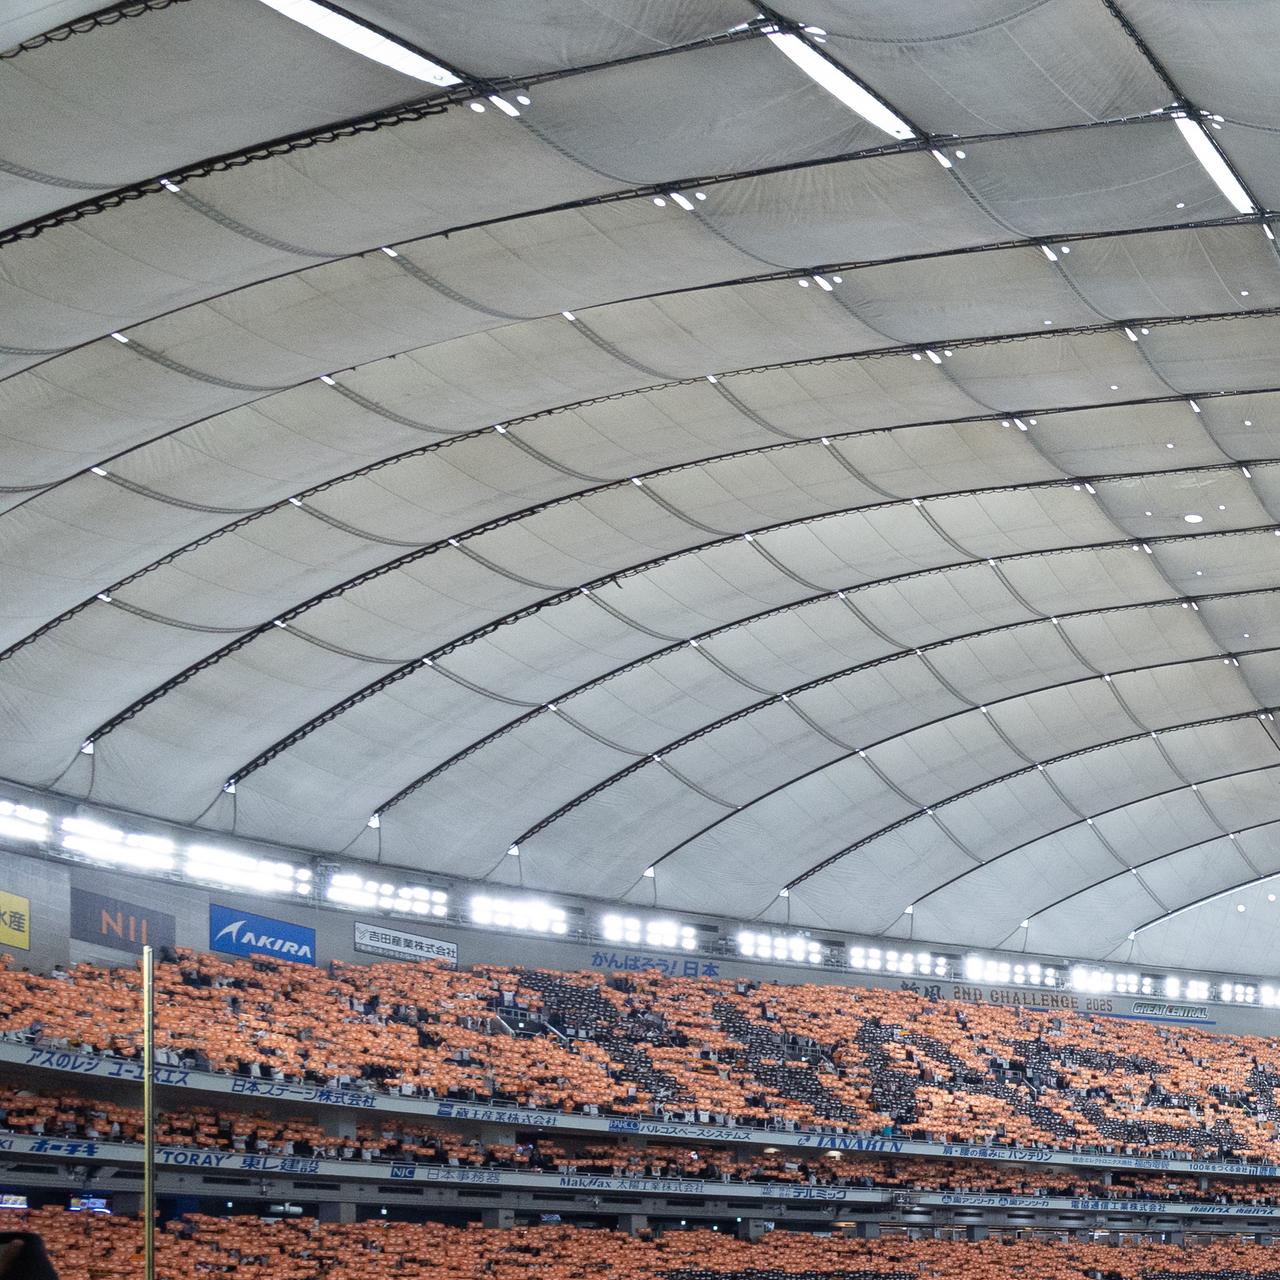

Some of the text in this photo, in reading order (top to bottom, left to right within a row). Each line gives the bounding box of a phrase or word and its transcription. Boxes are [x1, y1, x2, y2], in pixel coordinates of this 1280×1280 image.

[242, 931, 312, 959] AKIRA
[368, 929, 457, 961] 吉田産業株式会社
[683, 957, 720, 978] 日本
[953, 985, 1113, 1013] 2ND CHALLENGE 2025
[1132, 1001, 1209, 1019] GREAT CENTRAL
[26, 1050, 190, 1087] アスのレジ ユーエスエス
[231, 1078, 377, 1109] 日本ステージ株式会社
[454, 1106, 558, 1128] 蔵王産業株式会社
[639, 1124, 752, 1141] パルコスペースシステムズ
[28, 1140, 99, 1157] ホーチキ
[817, 1136, 904, 1152] TANAKEN
[241, 1156, 321, 1175] 東レ建設
[392, 1167, 501, 1184] NJC 日本事務器
[616, 1179, 705, 1194] 太陽工業株式会社
